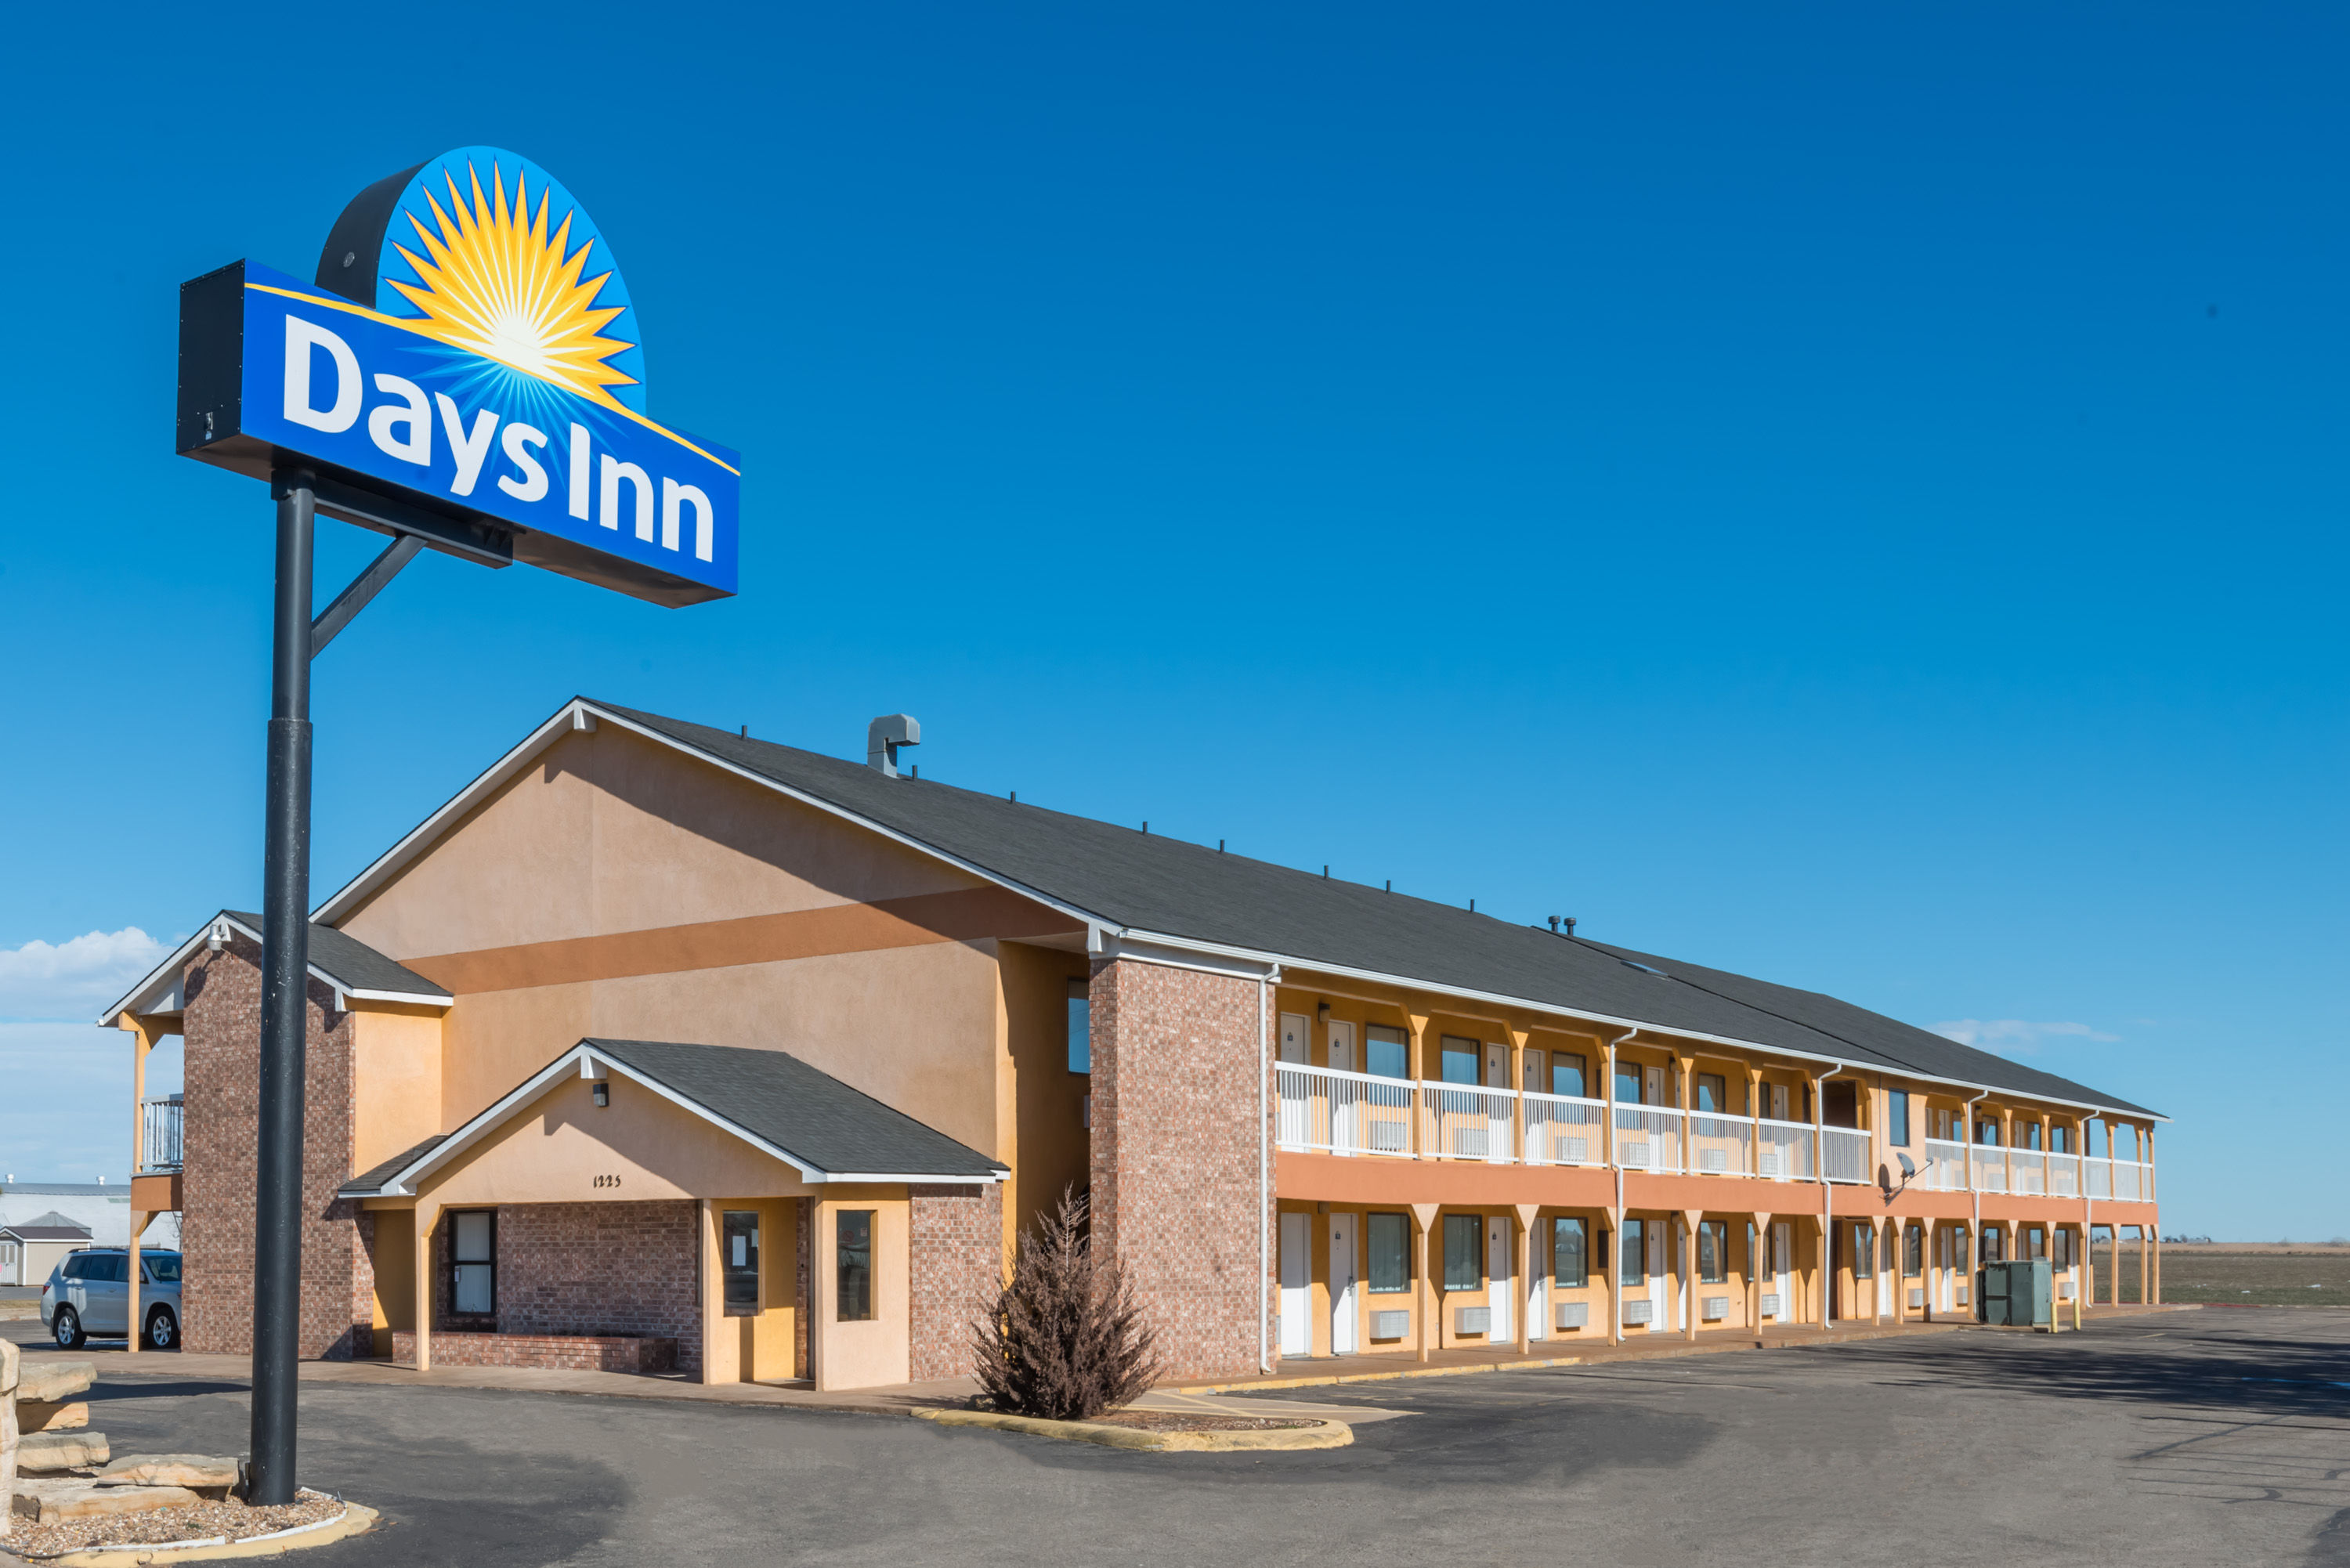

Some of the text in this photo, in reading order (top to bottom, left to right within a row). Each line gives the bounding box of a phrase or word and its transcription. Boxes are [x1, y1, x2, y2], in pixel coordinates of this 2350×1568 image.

[284, 314, 714, 562] Days Inn
[593, 1174, 621, 1188] 1225
